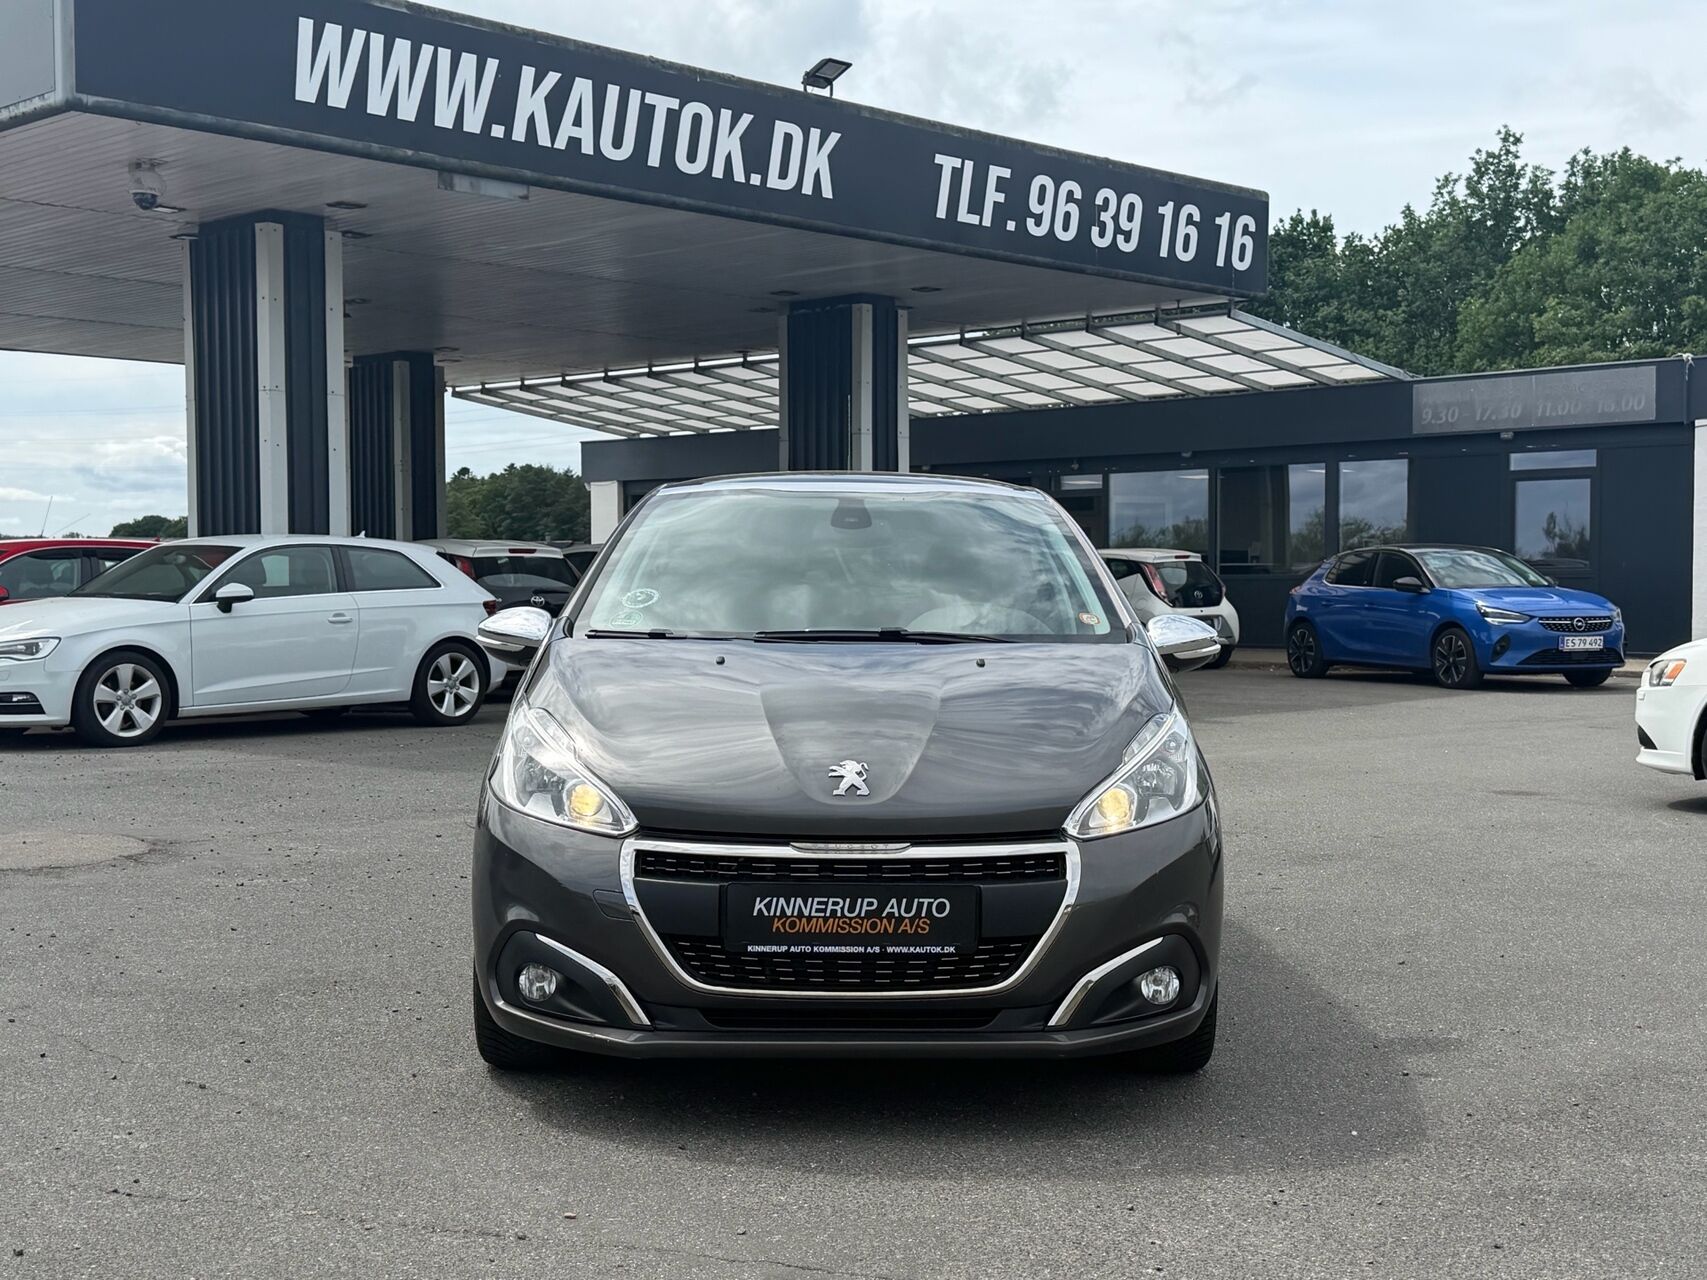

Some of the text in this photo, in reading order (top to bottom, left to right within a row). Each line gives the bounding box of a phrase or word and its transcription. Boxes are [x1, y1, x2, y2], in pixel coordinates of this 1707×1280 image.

[295, 16, 842, 200] WWW.KAUTOK.DK
[933, 152, 1257, 271] TLF. 96 39 16 16
[1565, 638, 1577, 648] ES
[1577, 638, 1588, 648] 79
[753, 897, 950, 918] KINNERUP AUTO
[772, 918, 931, 934] KOMMISSION A/S
[747, 945, 788, 953] KINNERUP
[789, 945, 812, 953] AUTO
[813, 945, 865, 954] KOMMISSION
[866, 946, 881, 954] A/S
[886, 946, 956, 954] WWW.KAUTOK.DK
